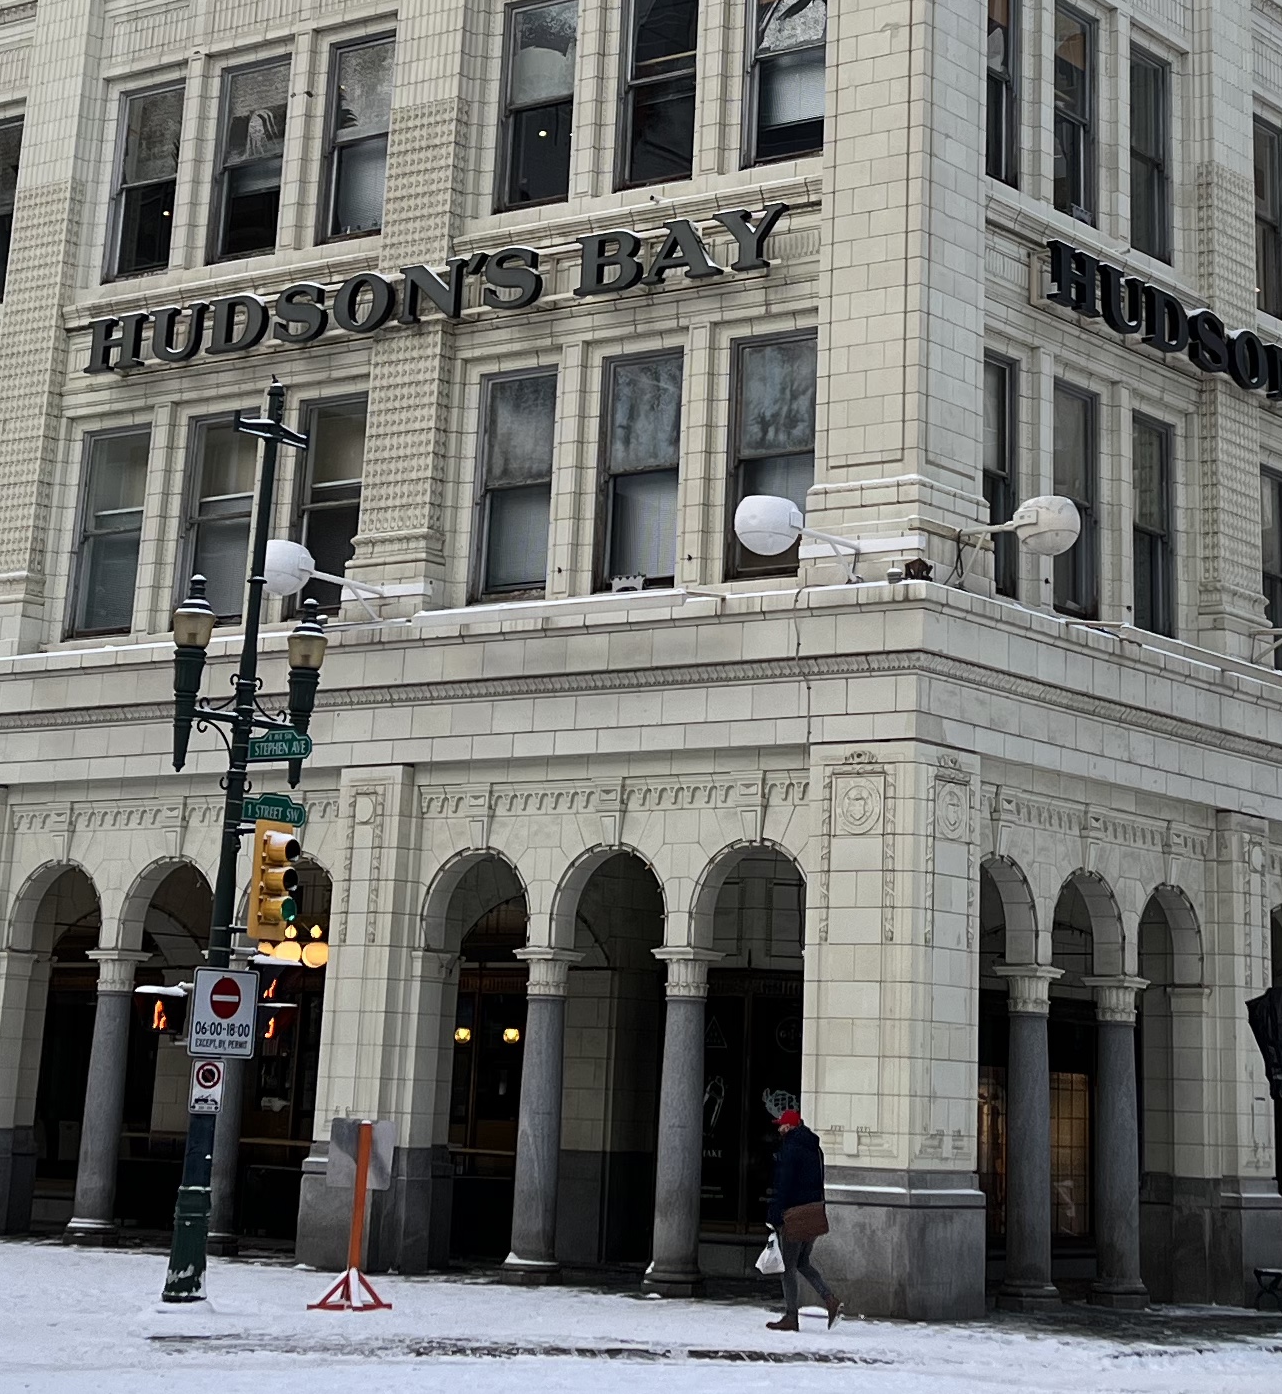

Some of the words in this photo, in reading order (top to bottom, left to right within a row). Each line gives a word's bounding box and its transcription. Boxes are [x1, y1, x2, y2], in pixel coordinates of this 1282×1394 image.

[83, 245, 543, 374] HUDSON'S
[573, 201, 790, 298] BAY
[254, 741, 289, 756] STEPHEN
[291, 740, 306, 753] AVE
[247, 804, 252, 816] 1
[255, 805, 283, 820] STREET
[286, 808, 301, 822] SW
[195, 1021, 250, 1037] 06:00-18:00
